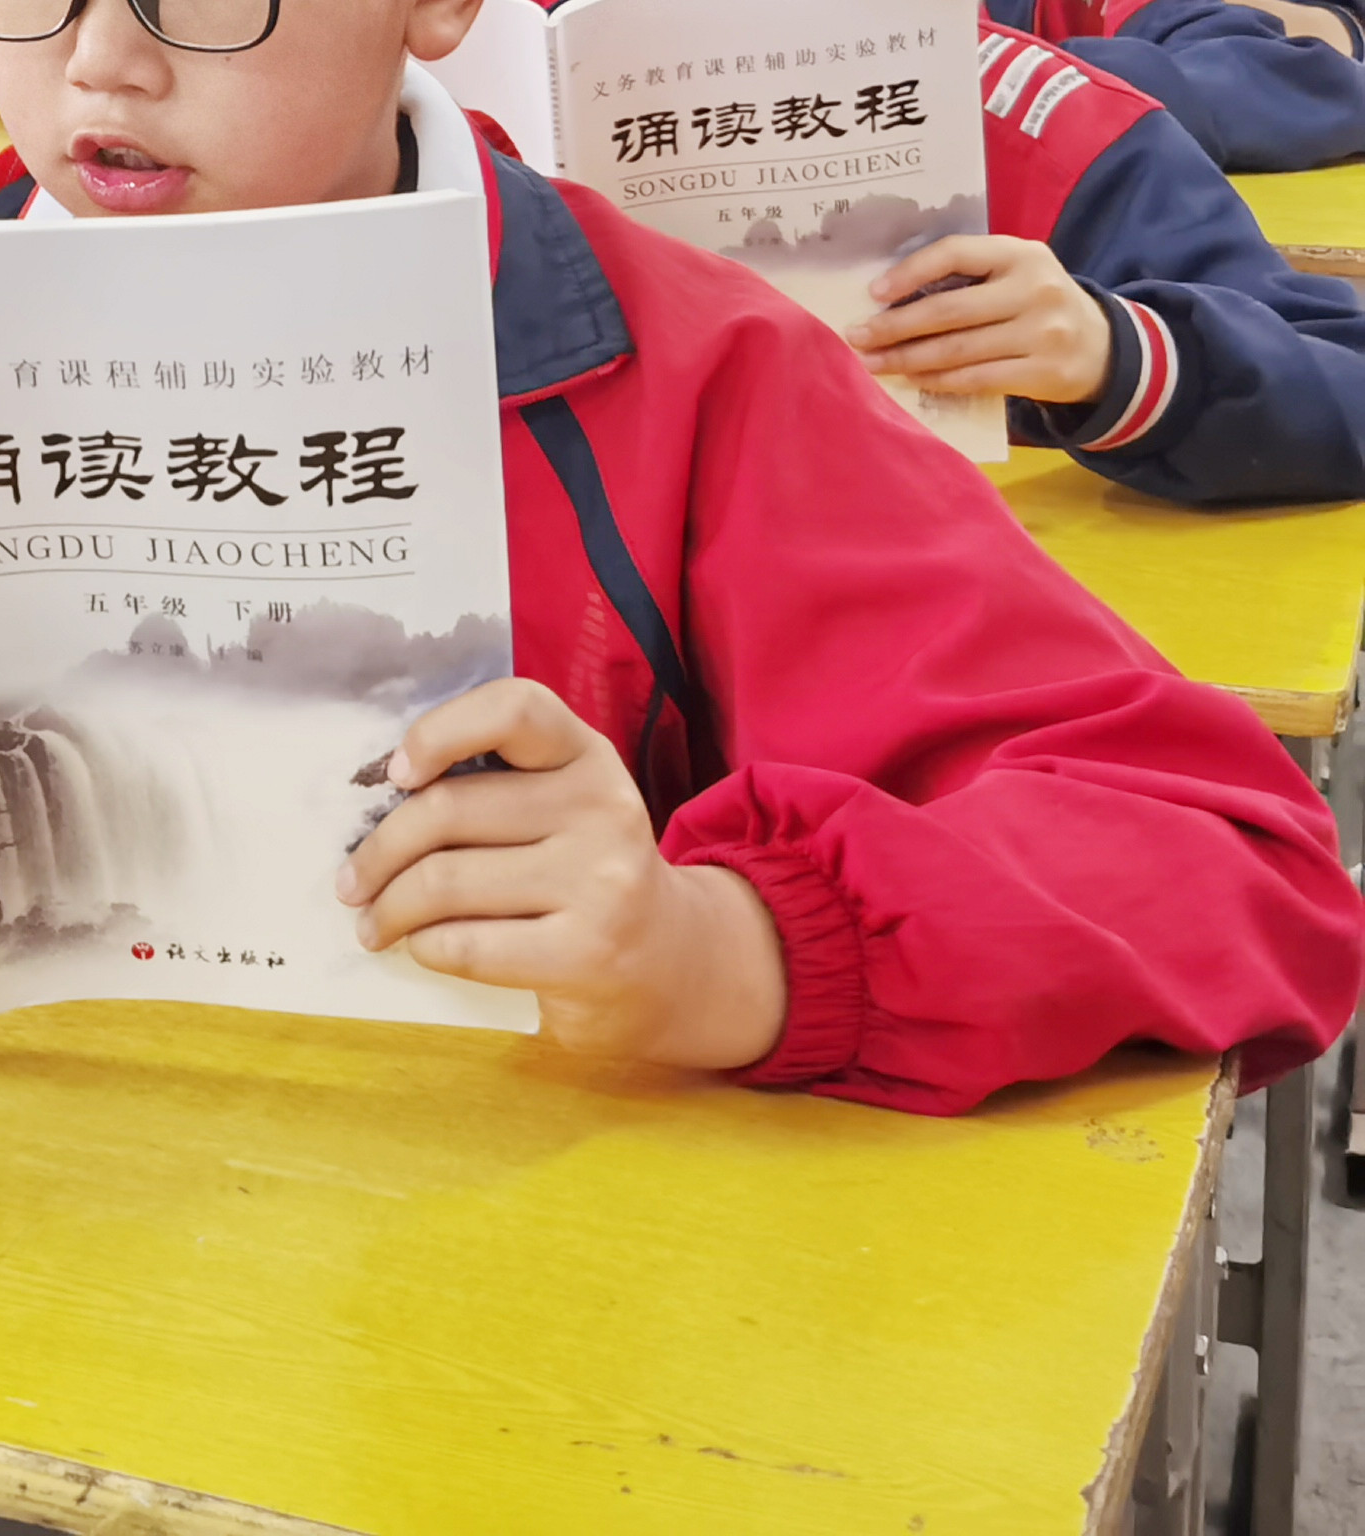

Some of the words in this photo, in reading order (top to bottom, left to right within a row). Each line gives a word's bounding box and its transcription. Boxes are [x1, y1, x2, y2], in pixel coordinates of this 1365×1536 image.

[591, 26, 938, 101] 义务教育课程辅助实验教材
[610, 79, 928, 163] 诵读教程
[622, 168, 737, 201] SONGDU
[757, 147, 923, 184] JIAOCHENG
[146, 534, 410, 569] JIAOCHENG
[84, 592, 187, 618] 五年级
[227, 599, 293, 623] 下册
